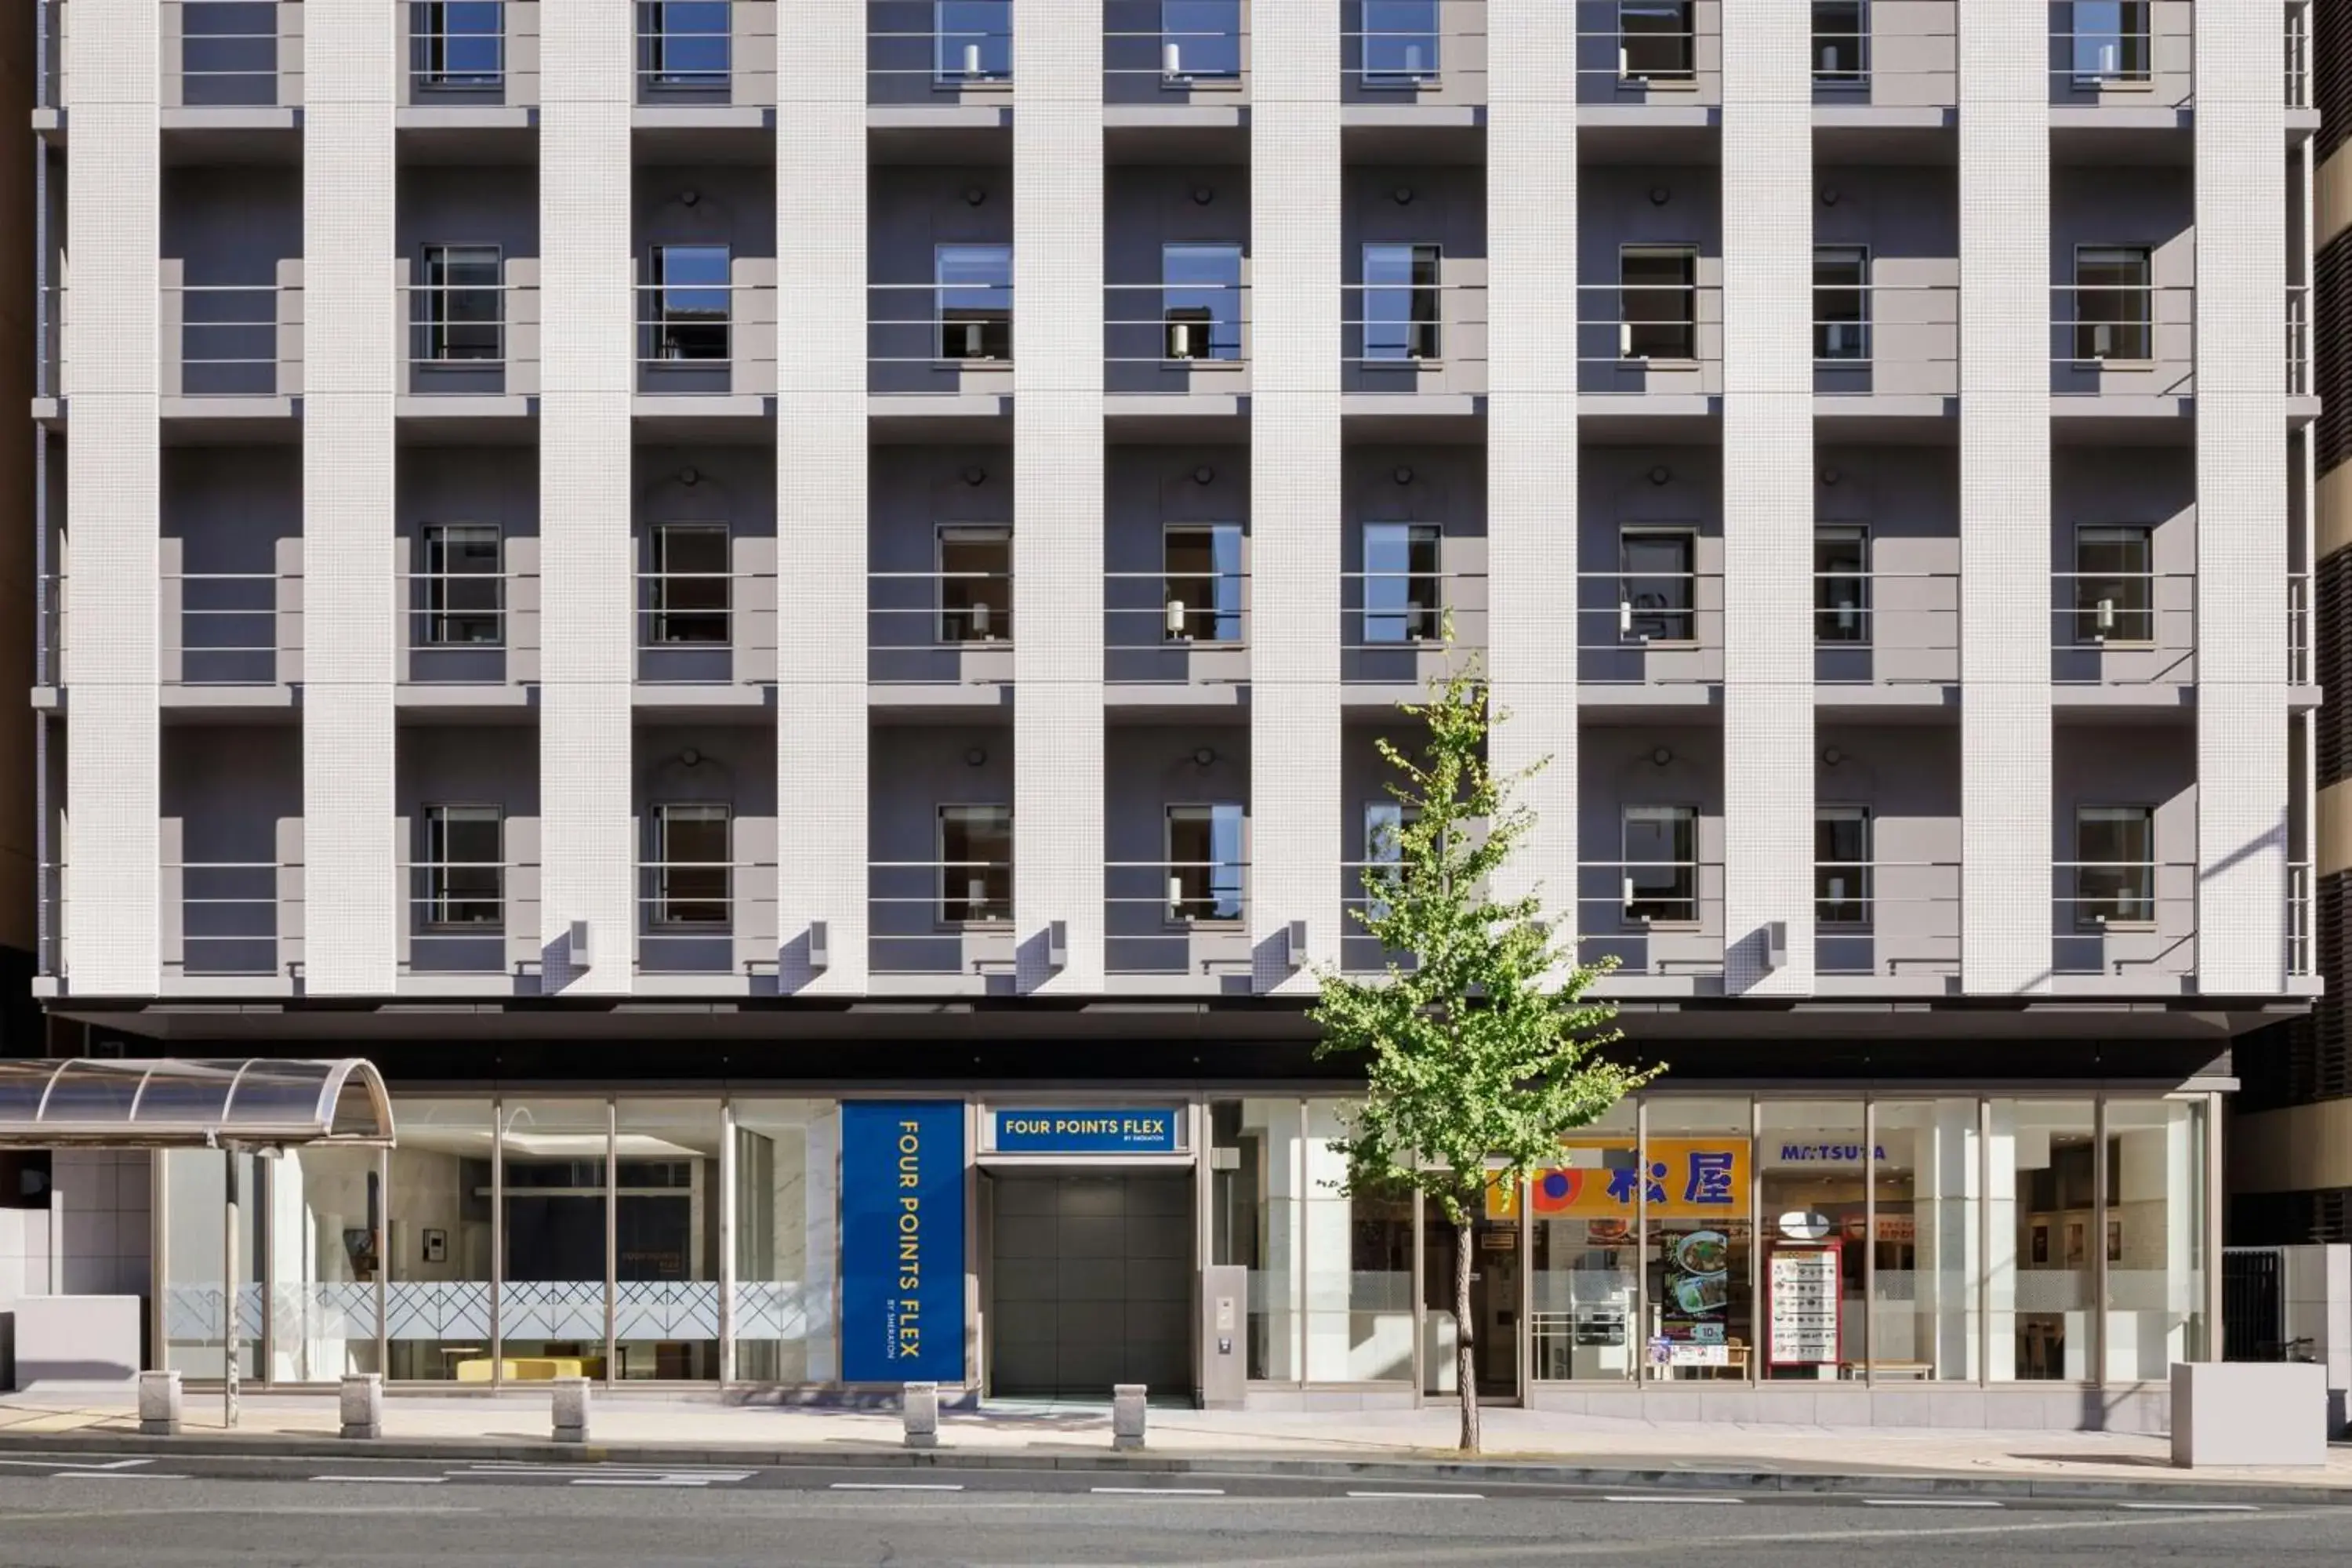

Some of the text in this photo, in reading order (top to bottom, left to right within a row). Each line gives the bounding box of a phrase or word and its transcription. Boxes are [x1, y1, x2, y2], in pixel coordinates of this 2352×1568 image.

[1006, 1119, 1164, 1134] FOUR POINTS FLEX
[1607, 1147, 1733, 1204] 松屋
[899, 1121, 920, 1358] FOUR POINTS FLEX
[887, 1299, 896, 1359] BY SHERATON
